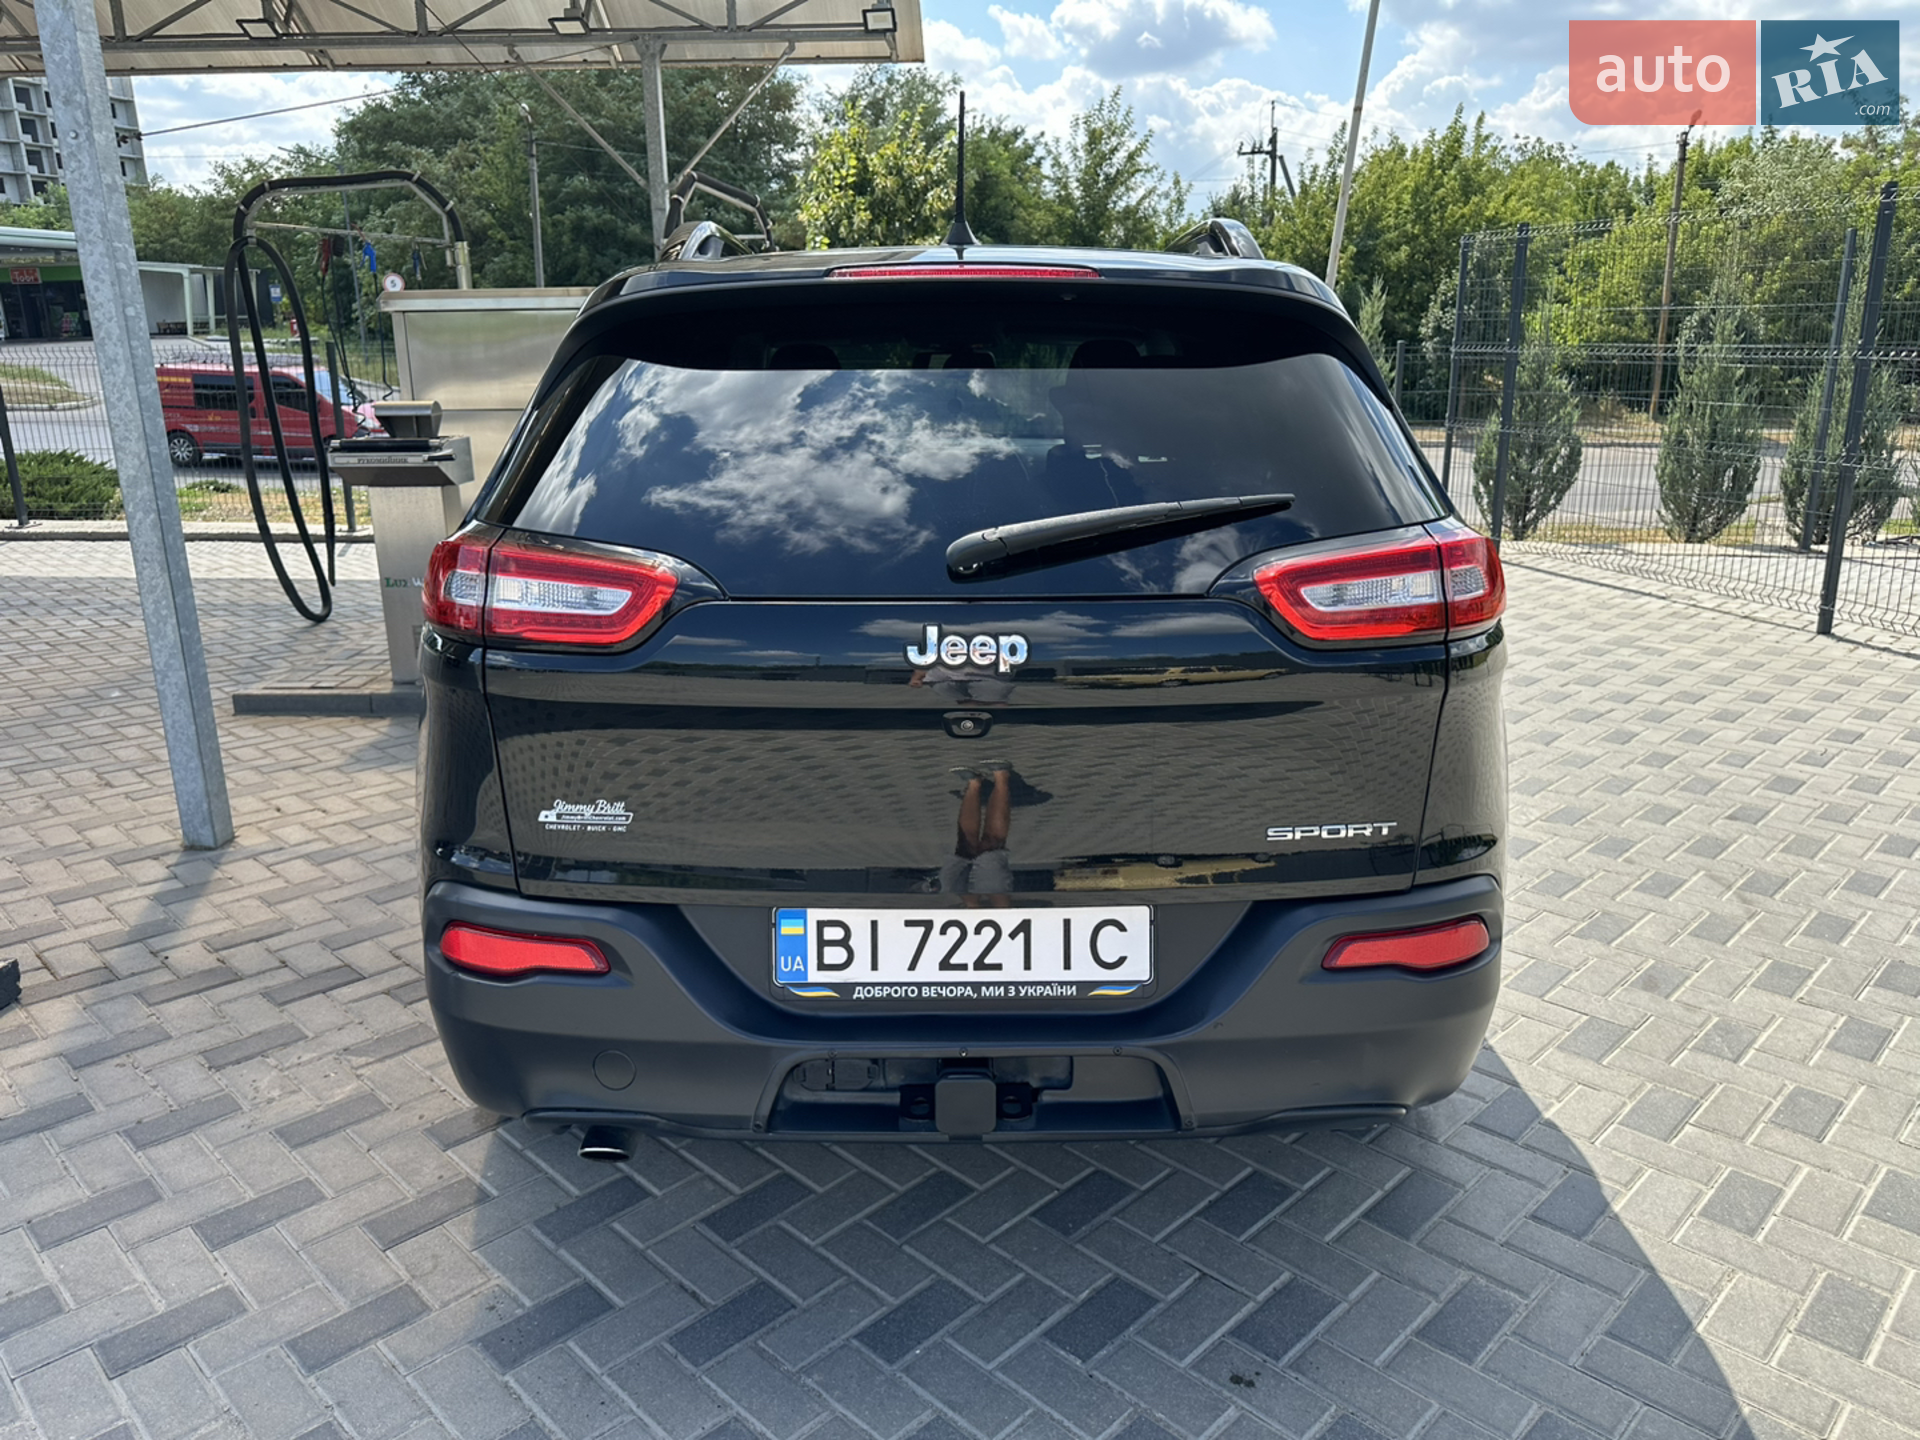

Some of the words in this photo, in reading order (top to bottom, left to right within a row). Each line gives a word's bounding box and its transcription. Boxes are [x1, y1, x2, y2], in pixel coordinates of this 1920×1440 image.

[390, 280, 397, 288] 5
[905, 625, 1029, 673] Jeep
[553, 799, 596, 816] Jimmy
[595, 799, 626, 813] Britt
[544, 823, 581, 832] CHEVROLET
[586, 824, 607, 832] BUICK
[612, 825, 628, 833] GMC
[1266, 821, 1398, 841] SPORT
[816, 919, 880, 972] BI
[903, 918, 1032, 972] 7221
[1062, 917, 1129, 971] IC
[780, 955, 805, 972] UA
[852, 985, 918, 999] ДОБРОГО
[921, 985, 978, 999] ВЕЧОРА,
[980, 985, 1004, 997] МИ
[1007, 985, 1016, 997] З
[1018, 983, 1077, 997] УКРАЇНИ
